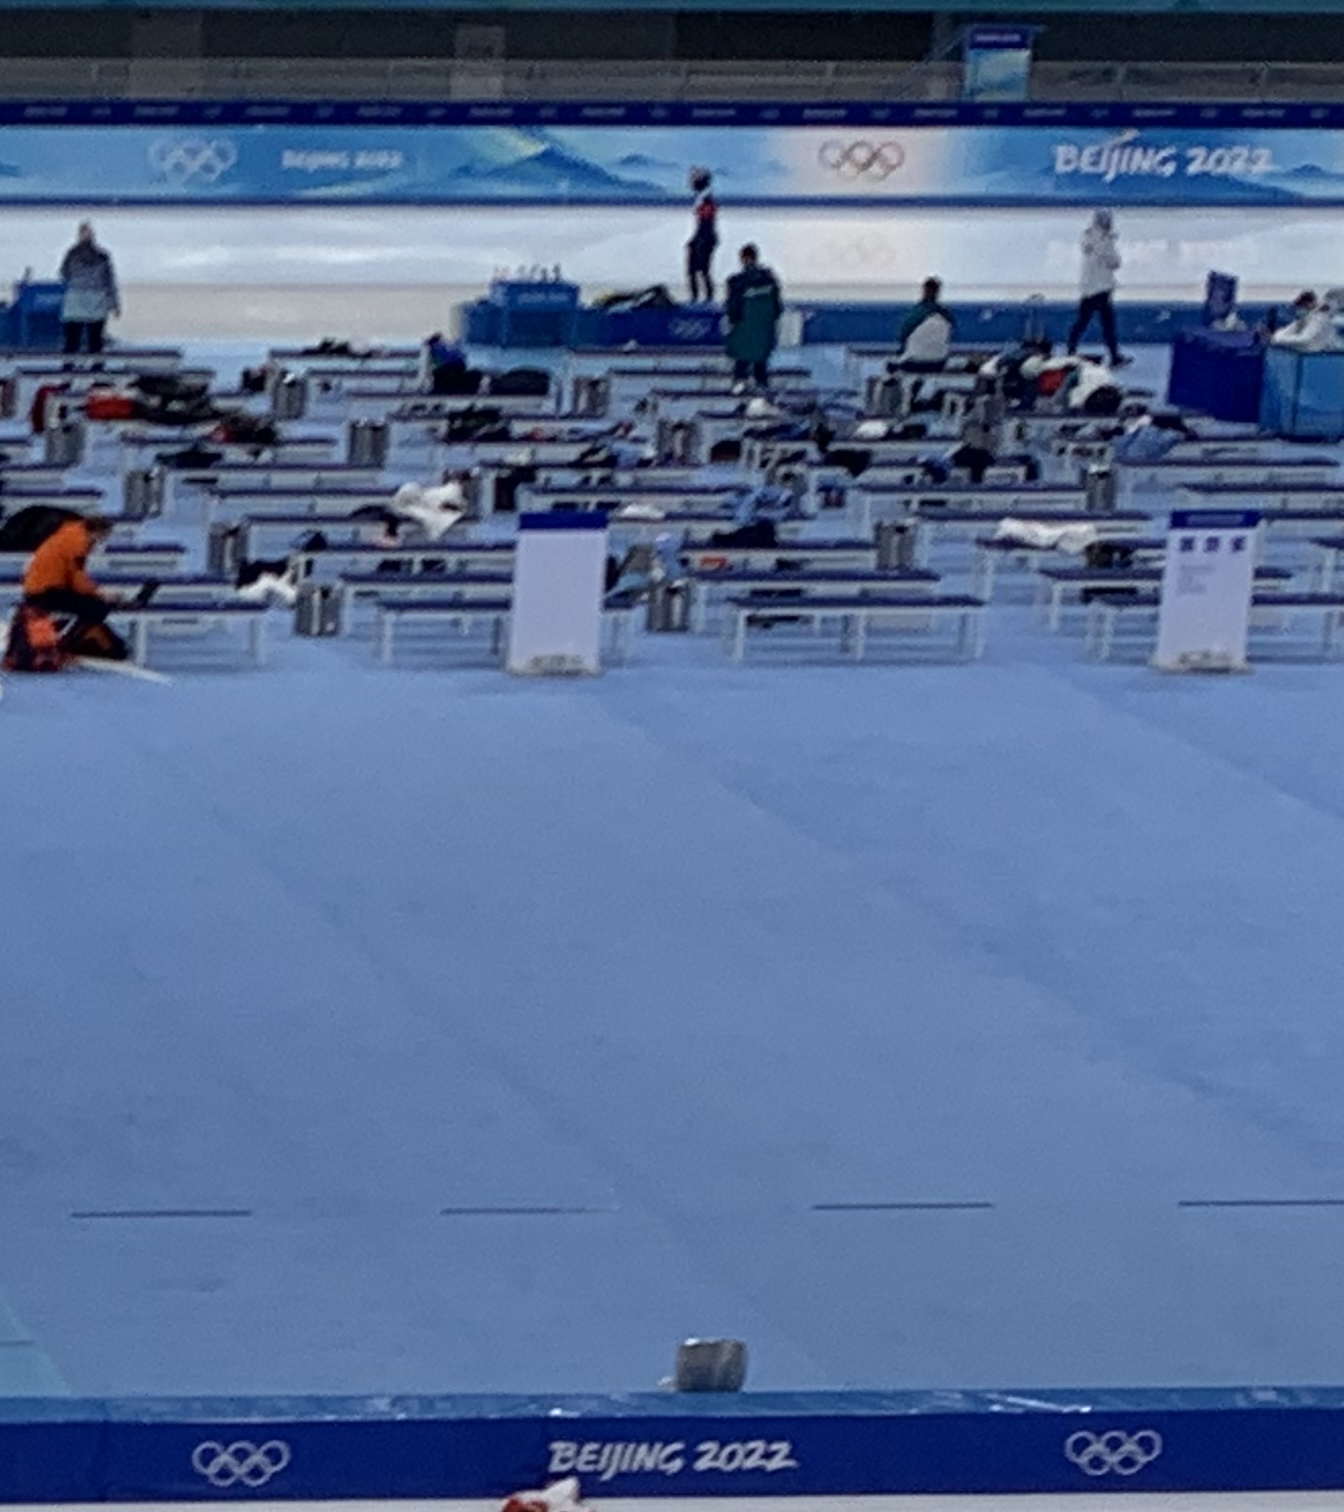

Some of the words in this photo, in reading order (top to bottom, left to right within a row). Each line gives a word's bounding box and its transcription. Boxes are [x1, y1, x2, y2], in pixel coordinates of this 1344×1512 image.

[1054, 145, 1177, 183] BEIJING
[1186, 145, 1280, 176] 2022
[548, 1440, 686, 1482] BEIJING
[693, 1440, 799, 1472] 2022
